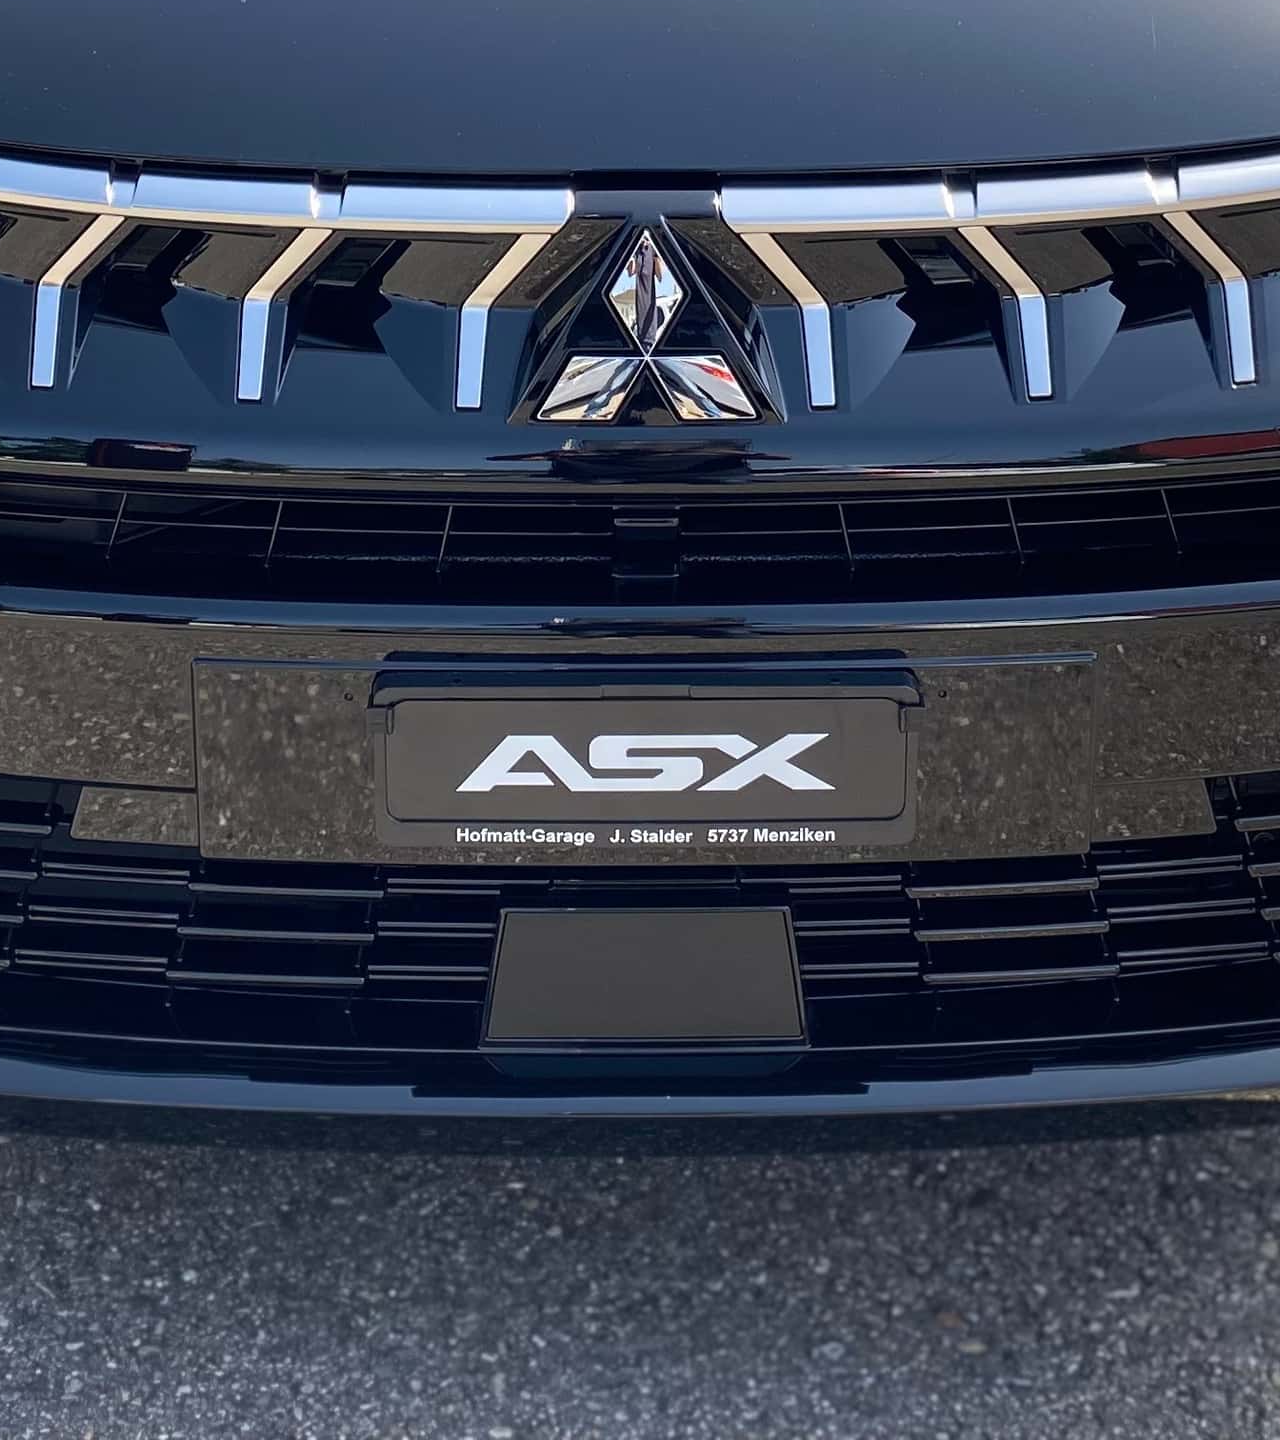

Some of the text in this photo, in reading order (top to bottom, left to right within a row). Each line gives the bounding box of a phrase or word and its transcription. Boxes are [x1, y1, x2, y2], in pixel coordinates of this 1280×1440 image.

[455, 733, 837, 792] ASX
[455, 826, 837, 846] Hofmatt-Garage J. Stalder 5737 Menziken
